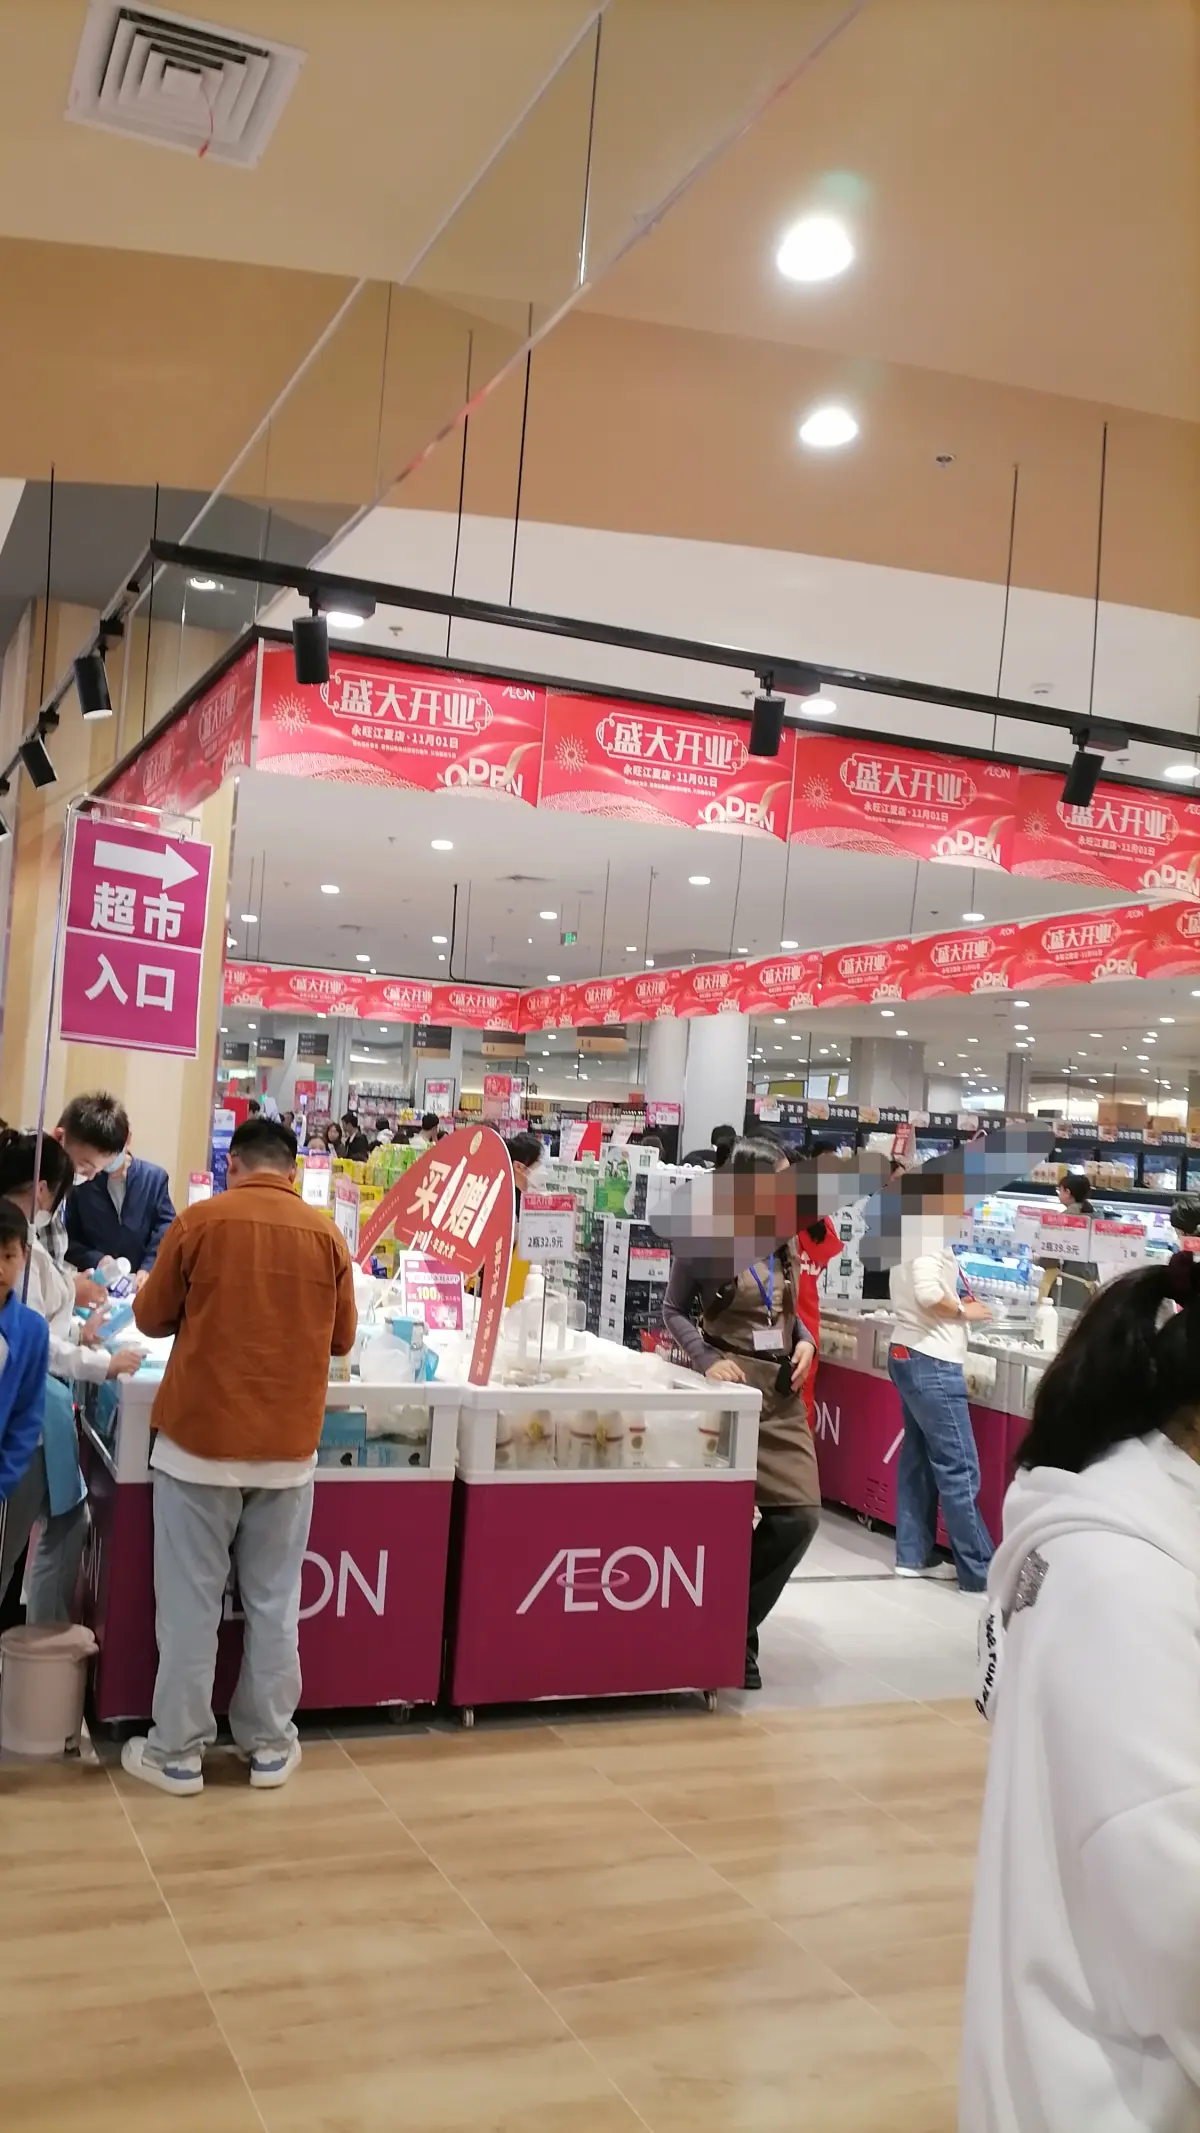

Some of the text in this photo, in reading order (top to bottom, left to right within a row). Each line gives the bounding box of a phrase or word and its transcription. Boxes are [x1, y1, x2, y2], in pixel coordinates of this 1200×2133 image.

[339, 679, 478, 730] 盛大开业
[613, 722, 733, 770] 盛大开业
[443, 757, 523, 798] OPEN
[854, 761, 962, 805] 盛大开业
[704, 795, 775, 833] OPEN
[1070, 800, 1168, 841] 盛大开业
[935, 829, 1001, 864] OPEN
[1143, 864, 1200, 897] OPEN
[90, 881, 185, 940] 超市
[936, 939, 991, 963] 盛大开业
[1050, 923, 1113, 950] 盛大开业
[225, 970, 247, 985] 开业
[764, 964, 803, 985] 盛大开业
[844, 953, 887, 976] 盛大开业
[972, 971, 1010, 991] OPEN
[1093, 958, 1138, 979] OPEN
[84, 953, 175, 1012] 入口
[295, 976, 343, 995] 盛大开业
[388, 987, 433, 1003] 盛大开业
[454, 991, 498, 1009] 盛大开业
[516, 1545, 706, 1615] AEON
